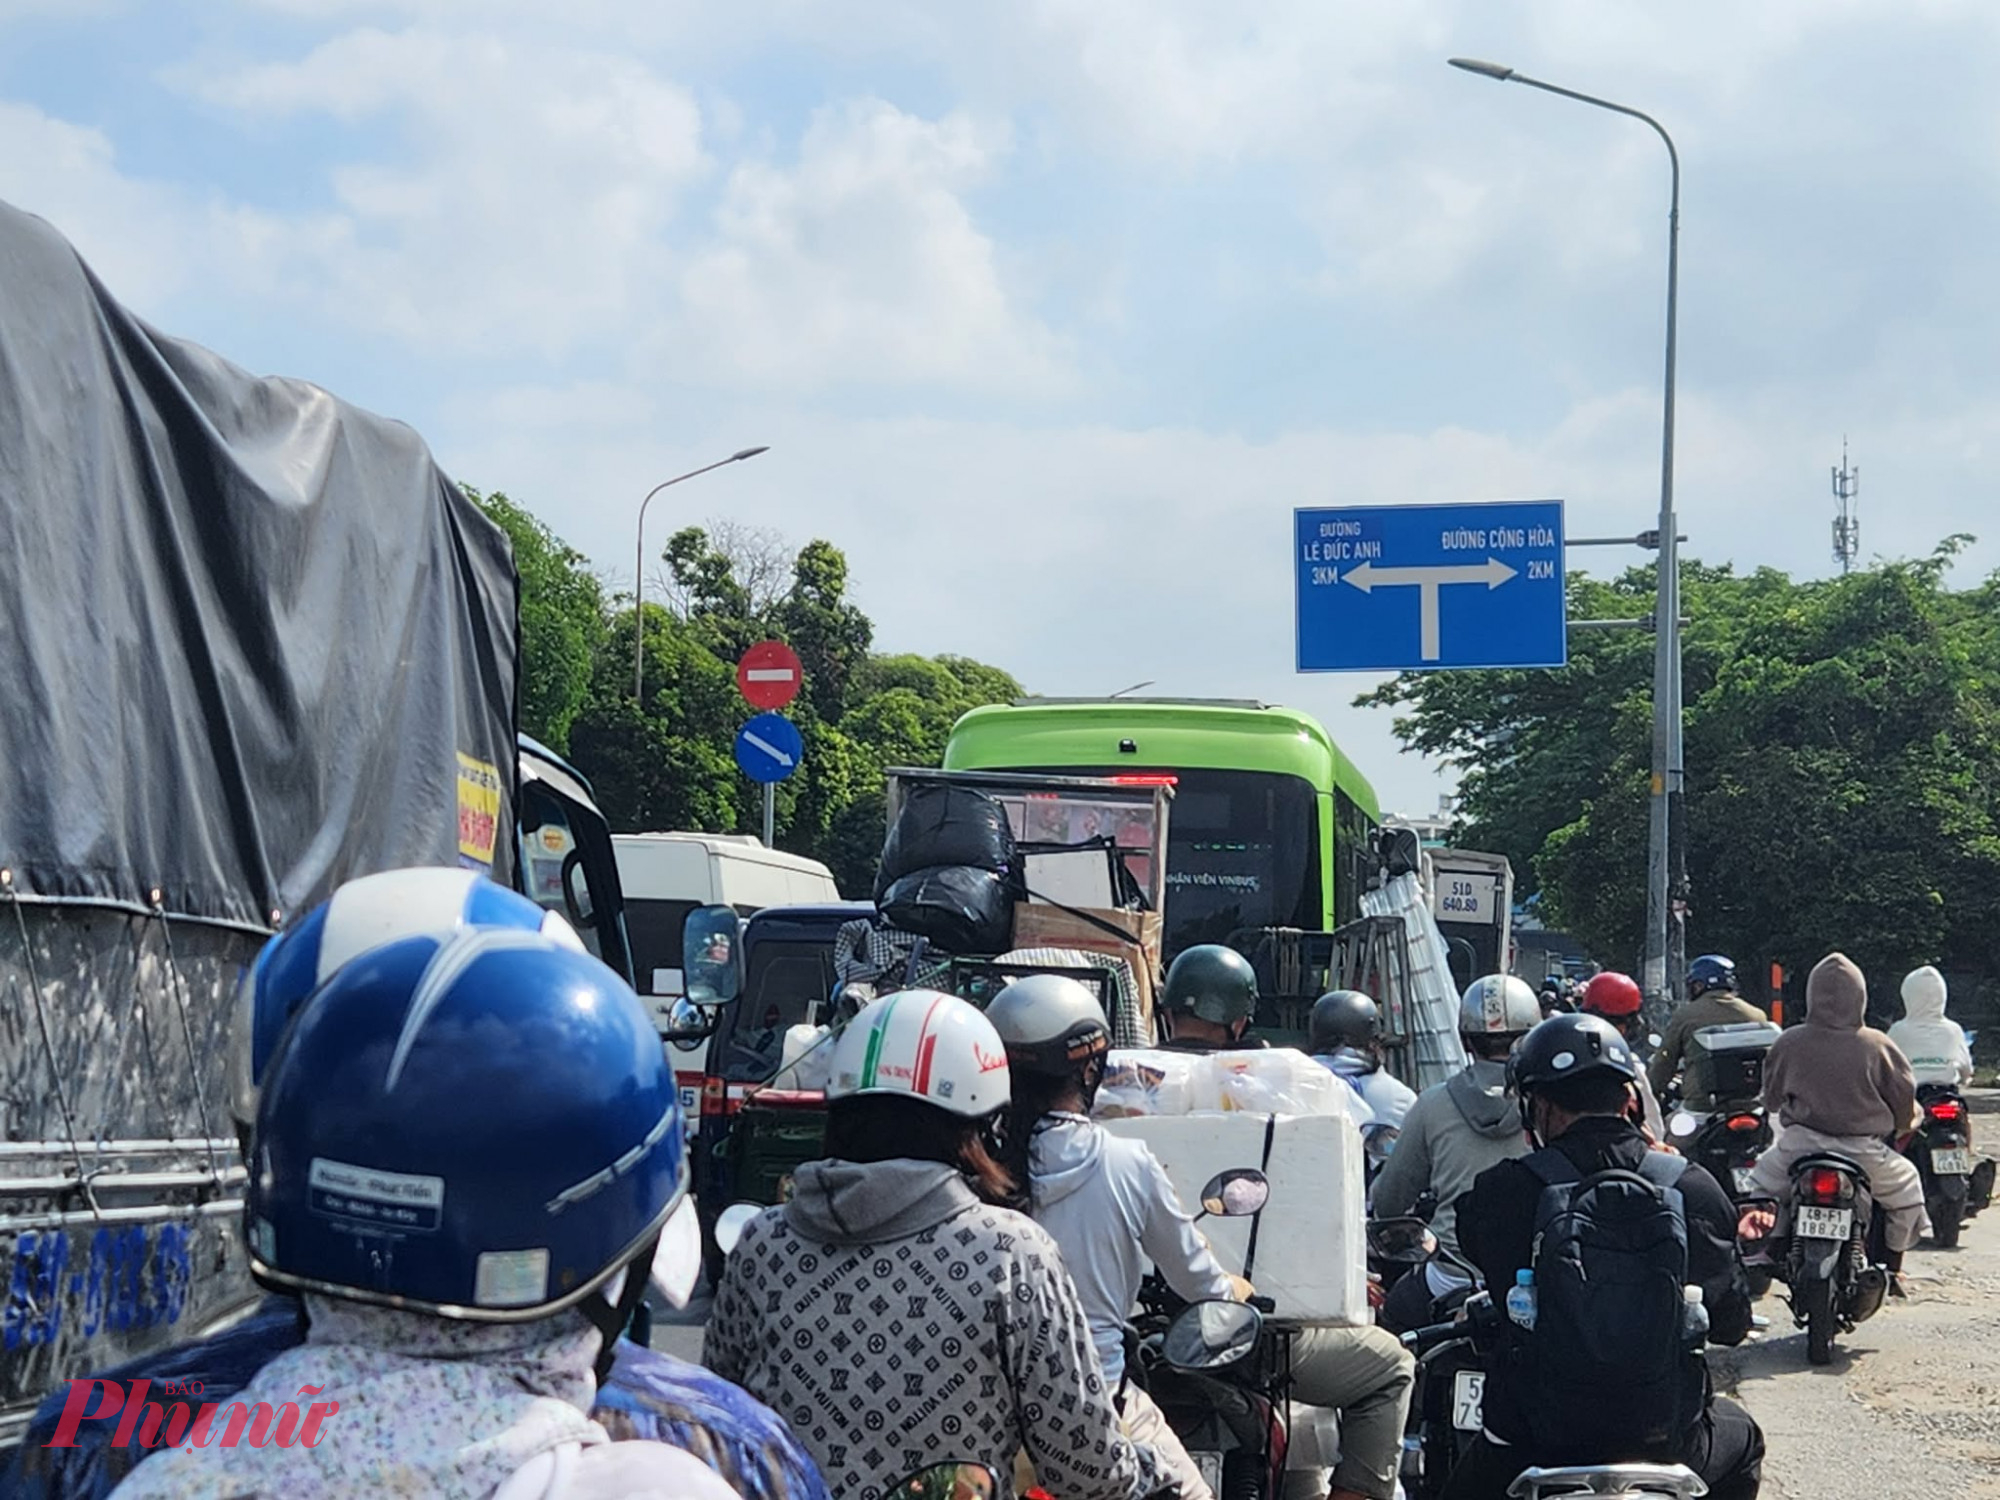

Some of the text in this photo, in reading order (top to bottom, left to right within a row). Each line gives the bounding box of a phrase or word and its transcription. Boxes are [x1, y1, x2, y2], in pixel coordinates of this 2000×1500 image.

[1320, 518, 1361, 537] ĐƯỜNG
[1441, 524, 1555, 551] ĐƯỜNG CỘNG HÒA
[1303, 538, 1381, 561] LÊ ĐỨC ANH
[1311, 566, 1338, 585] 3KM
[1527, 560, 1555, 579] 2KM
[1452, 881, 1473, 896] 51D
